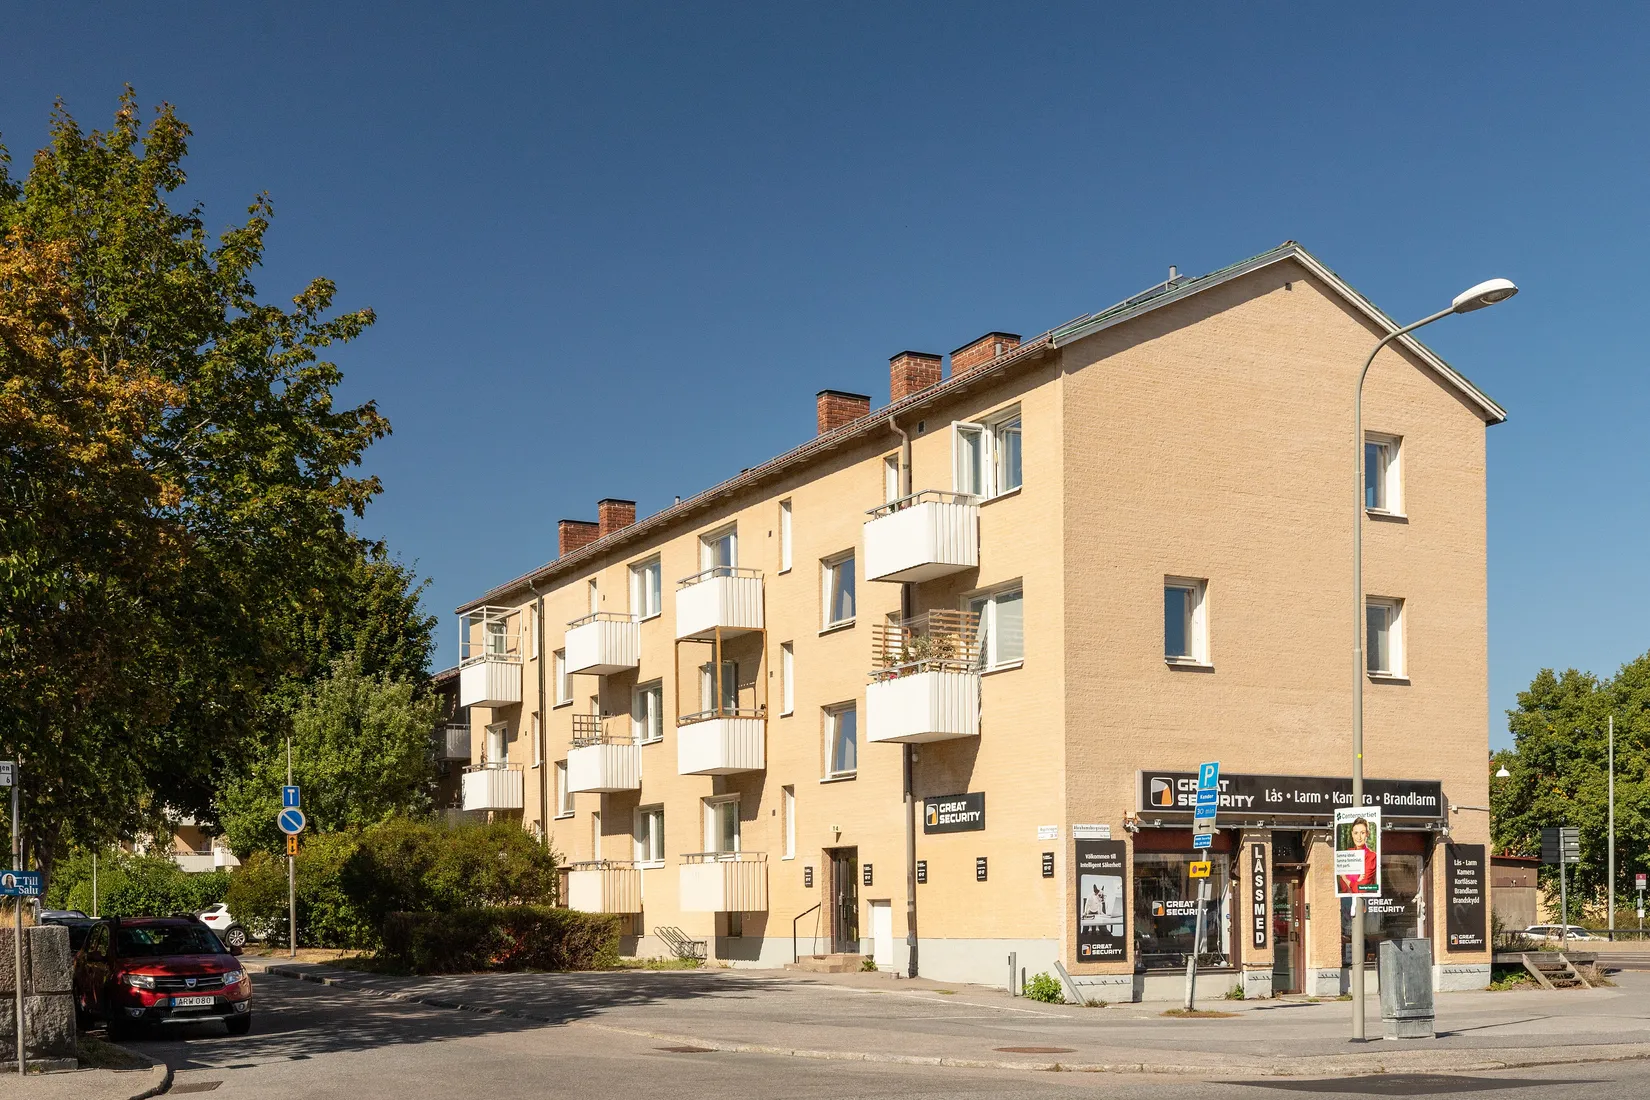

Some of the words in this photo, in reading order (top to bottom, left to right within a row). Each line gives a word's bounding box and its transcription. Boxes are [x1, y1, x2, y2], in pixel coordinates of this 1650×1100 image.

[6, 776, 11, 784] 6
[1204, 765, 1215, 787] P
[1177, 779, 1230, 792] GRT
[1177, 793, 1255, 807] SERITY
[1265, 788, 1283, 802] Lås
[1294, 790, 1321, 803] Larm
[1332, 791, 1373, 805] Kamra
[1383, 792, 1436, 806] Brandlarm
[939, 801, 967, 813] GREAT
[939, 811, 981, 824] SECURITY
[1454, 858, 1462, 866] Lås
[23, 876, 38, 886] Till
[18, 885, 39, 895] Salu
[1254, 846, 1265, 944] LÅSSMED
[1166, 900, 1195, 908] GREAT
[1453, 896, 1480, 905] Brandskydd
[1166, 908, 1208, 916] SECURIY
[1368, 905, 1405, 913] SECURITY
[195, 997, 211, 1005] 080
